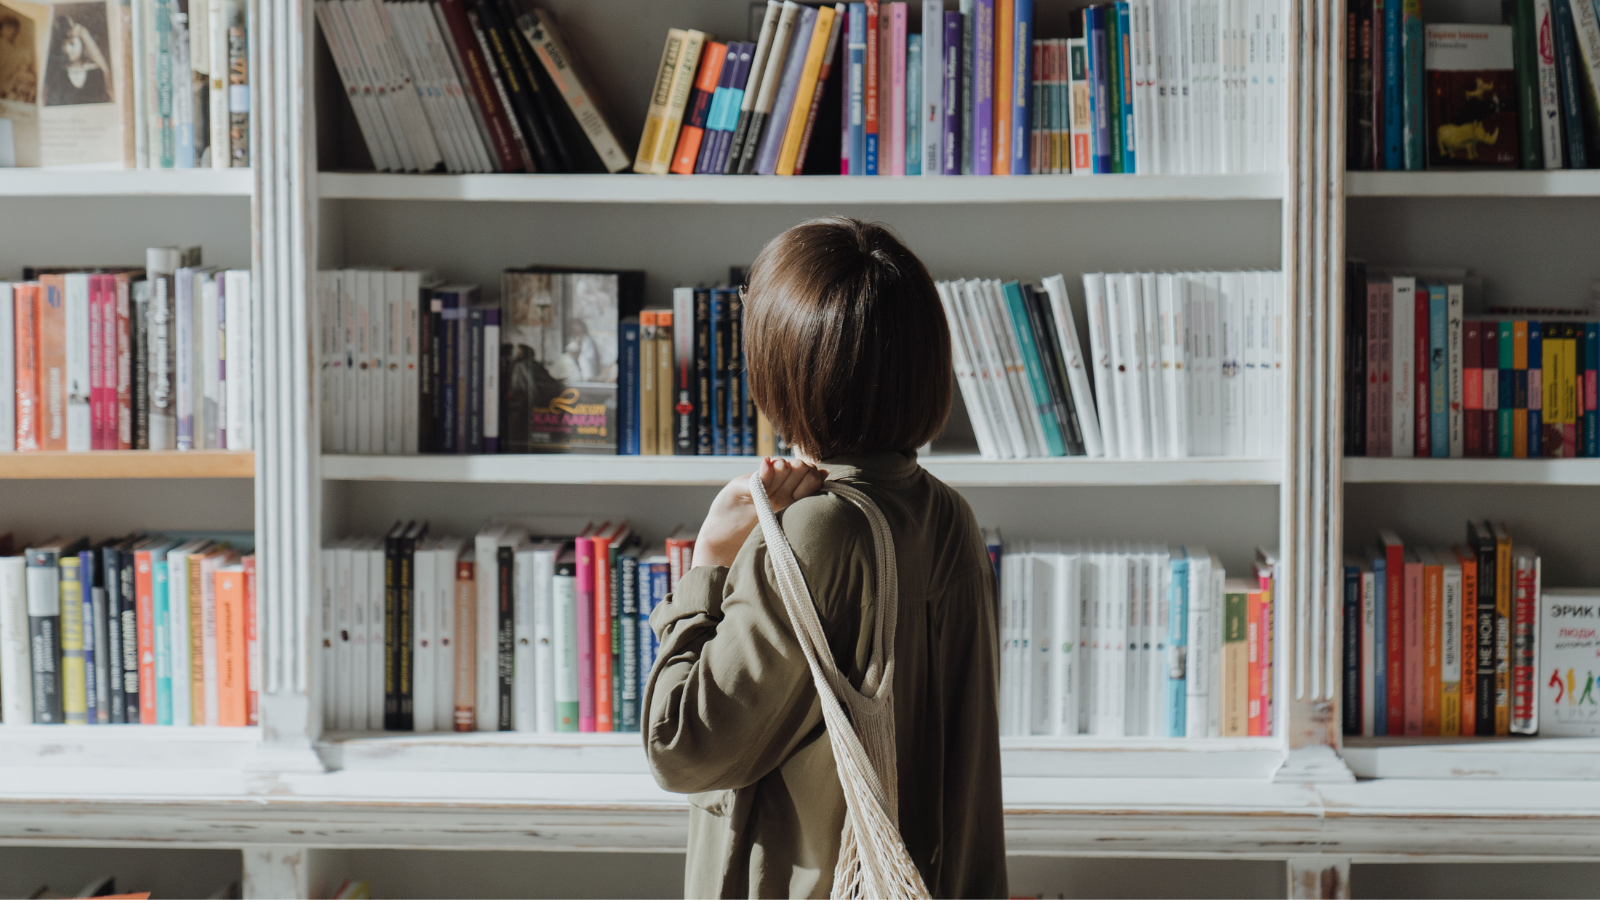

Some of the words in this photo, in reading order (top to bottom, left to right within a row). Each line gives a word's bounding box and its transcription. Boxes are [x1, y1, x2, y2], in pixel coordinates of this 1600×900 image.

[1551, 604, 1594, 618] ЭРИК
[1479, 612, 1492, 645] НОЙ
[1480, 648, 1492, 666] НЕ
